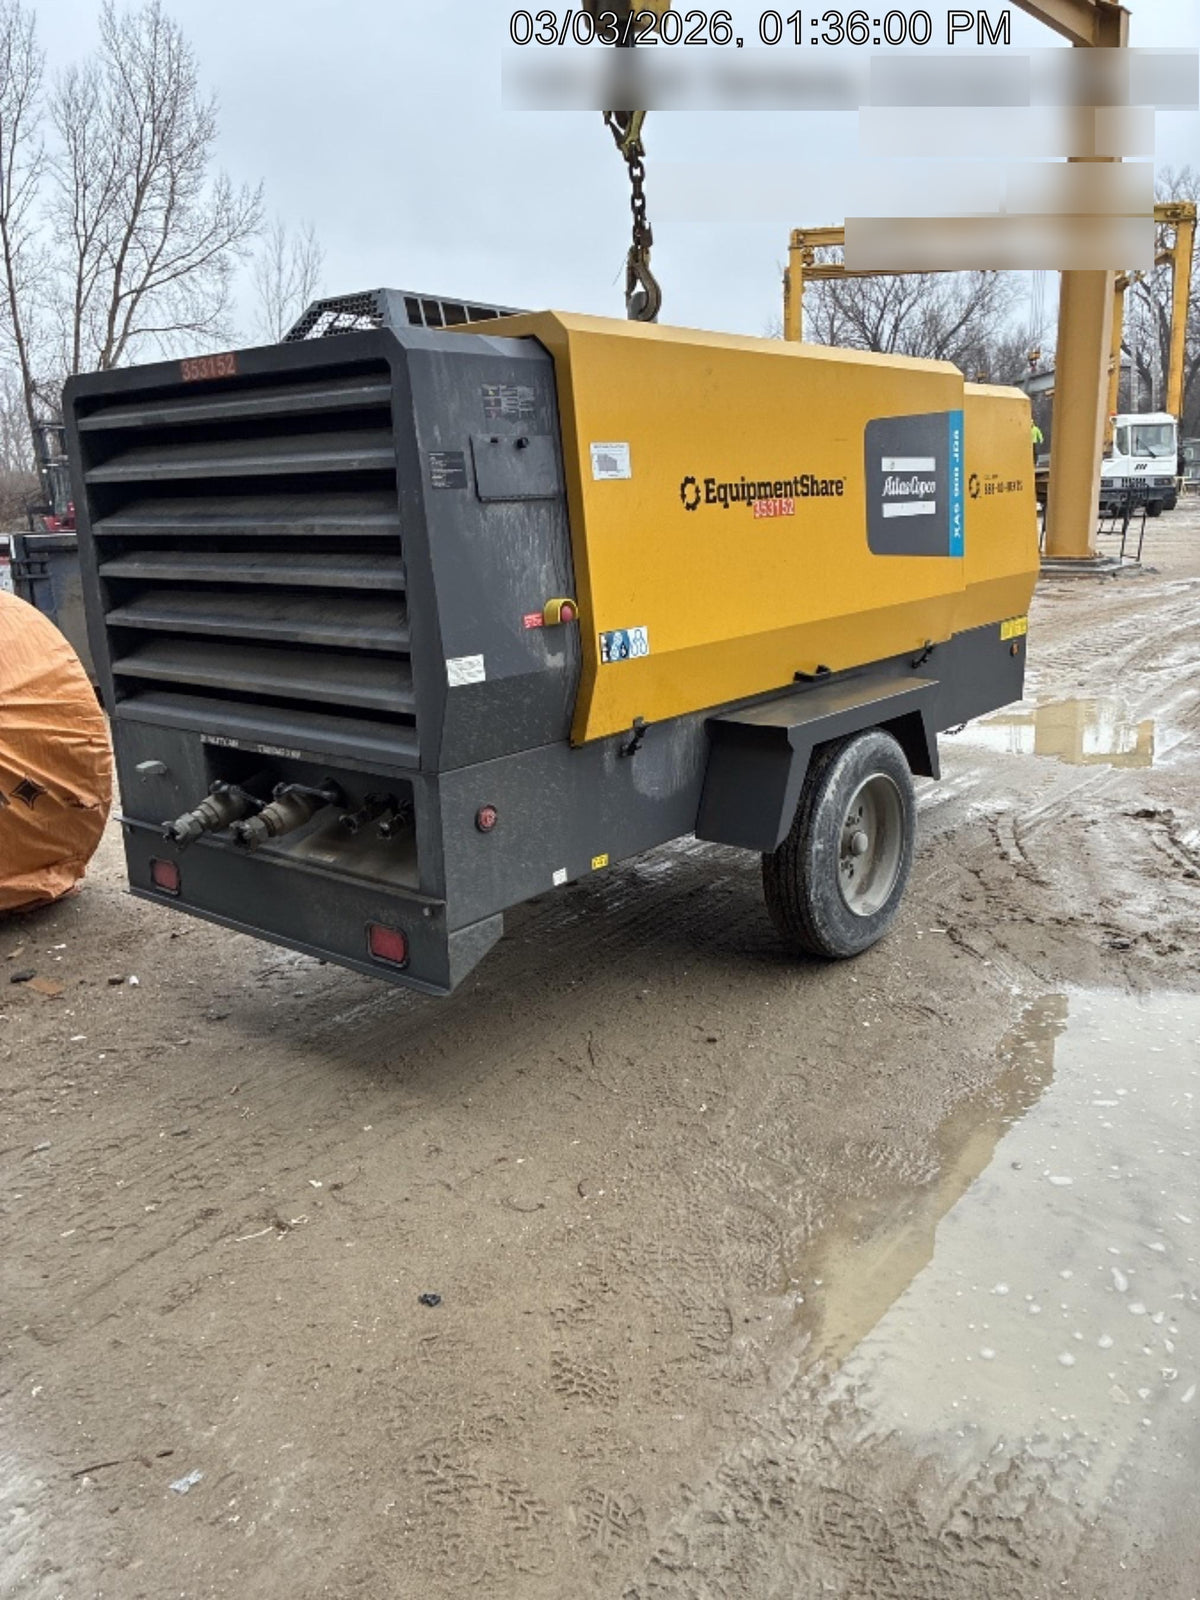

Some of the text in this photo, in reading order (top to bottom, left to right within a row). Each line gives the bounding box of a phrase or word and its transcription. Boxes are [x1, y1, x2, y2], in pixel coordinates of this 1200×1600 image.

[181, 354, 237, 380] 353152
[703, 474, 844, 509] EquipmentShare
[754, 499, 795, 518] 353152
